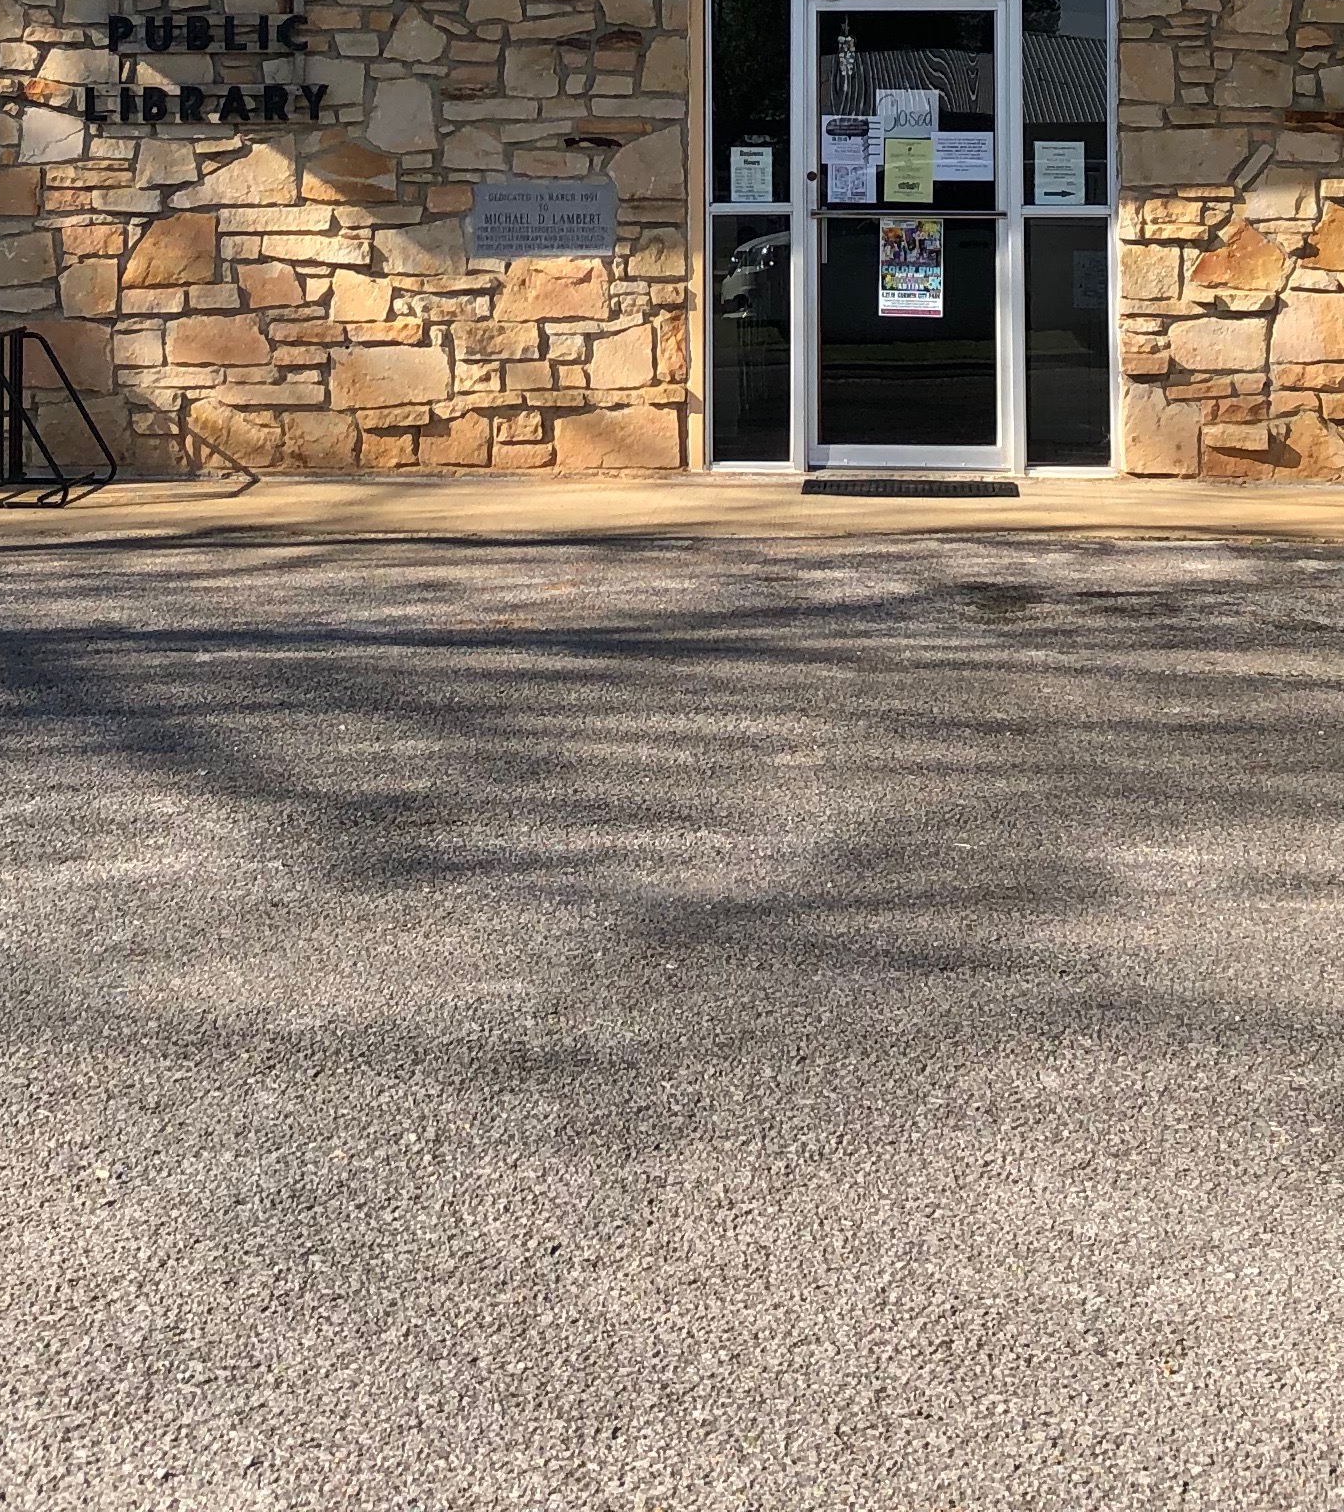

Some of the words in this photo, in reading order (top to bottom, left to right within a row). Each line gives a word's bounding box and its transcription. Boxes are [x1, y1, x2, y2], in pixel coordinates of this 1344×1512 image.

[108, 14, 309, 52] PUBLIC
[84, 84, 329, 122] LIBRARY
[877, 92, 932, 133] Closed
[537, 203, 549, 212] TO
[548, 192, 576, 202] MARCH
[484, 213, 532, 225] MICHAEL
[552, 213, 602, 225] LAMBERT
